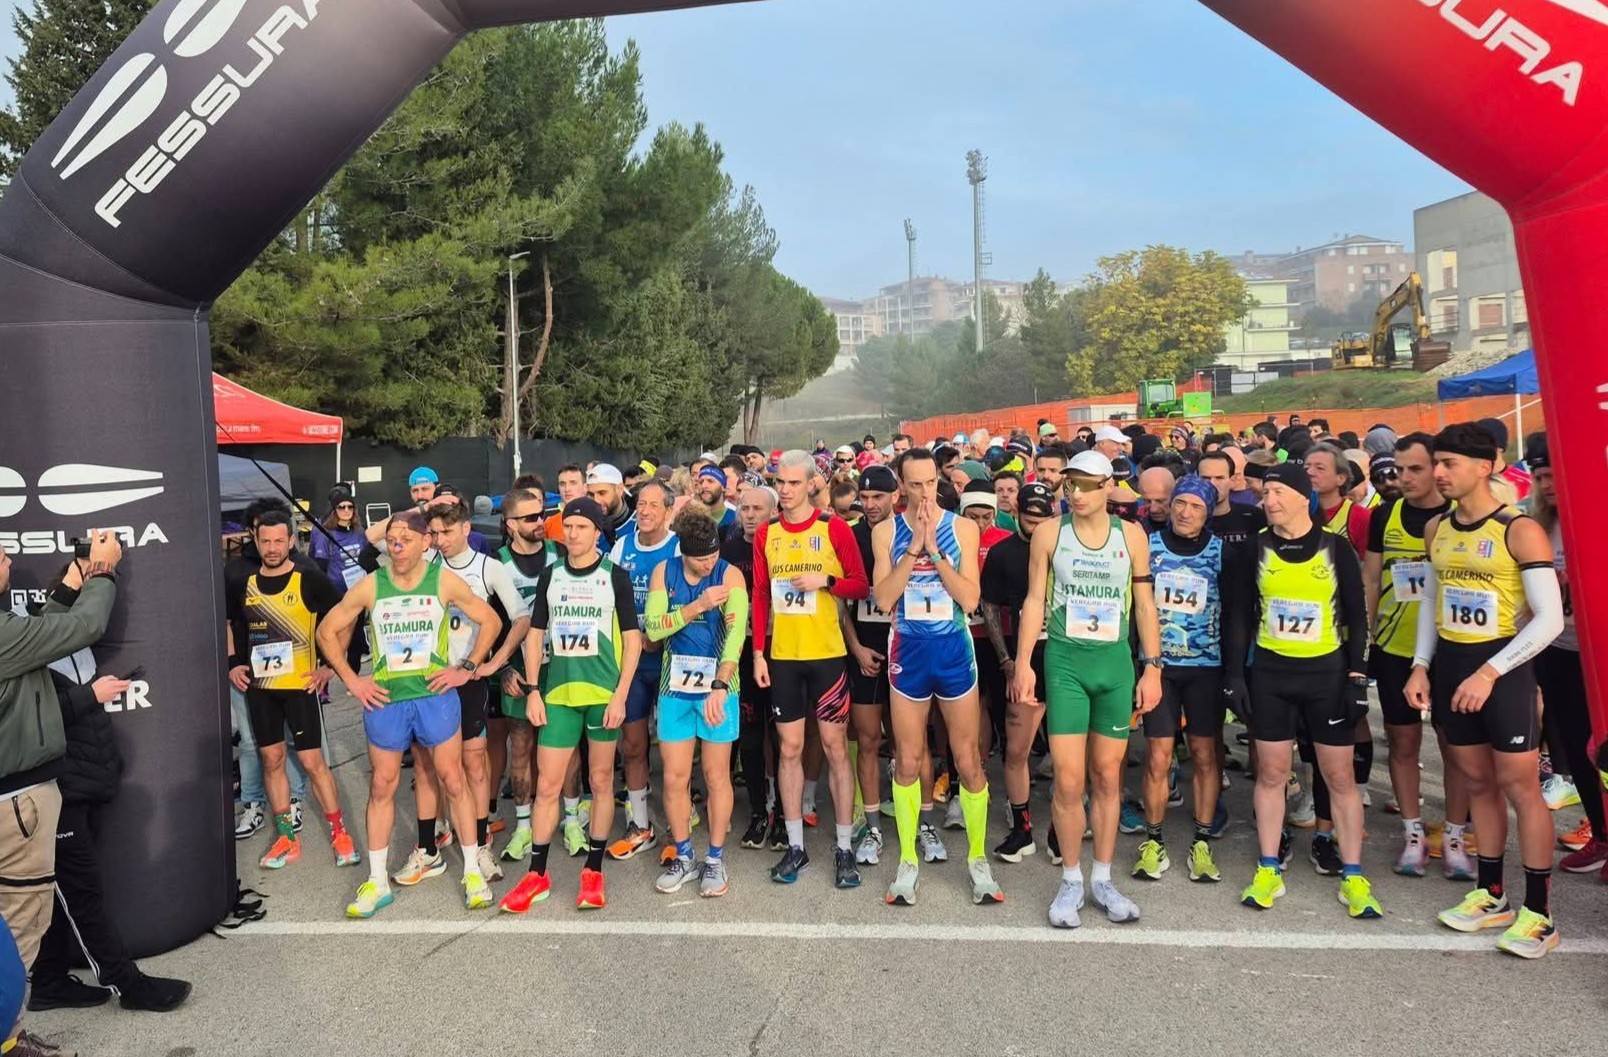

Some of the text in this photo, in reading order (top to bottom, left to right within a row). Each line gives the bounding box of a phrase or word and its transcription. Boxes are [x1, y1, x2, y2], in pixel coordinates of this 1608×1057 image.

[1418, 0, 1584, 107] URA
[785, 563, 822, 572] CAMERINO
[1446, 571, 1494, 583] CAMERINO
[784, 591, 806, 608] 94
[1065, 584, 1121, 599] STAMURA
[1164, 587, 1198, 608] 154
[554, 605, 603, 618] STAMURA
[924, 596, 931, 613] 1
[1087, 615, 1099, 632] 3
[1451, 603, 1488, 627] 180
[384, 620, 433, 634] STAMURA
[1278, 614, 1315, 634] 127
[560, 634, 590, 651] 174
[263, 655, 283, 671] 73
[402, 647, 412, 663] 2
[682, 670, 704, 687] 72
